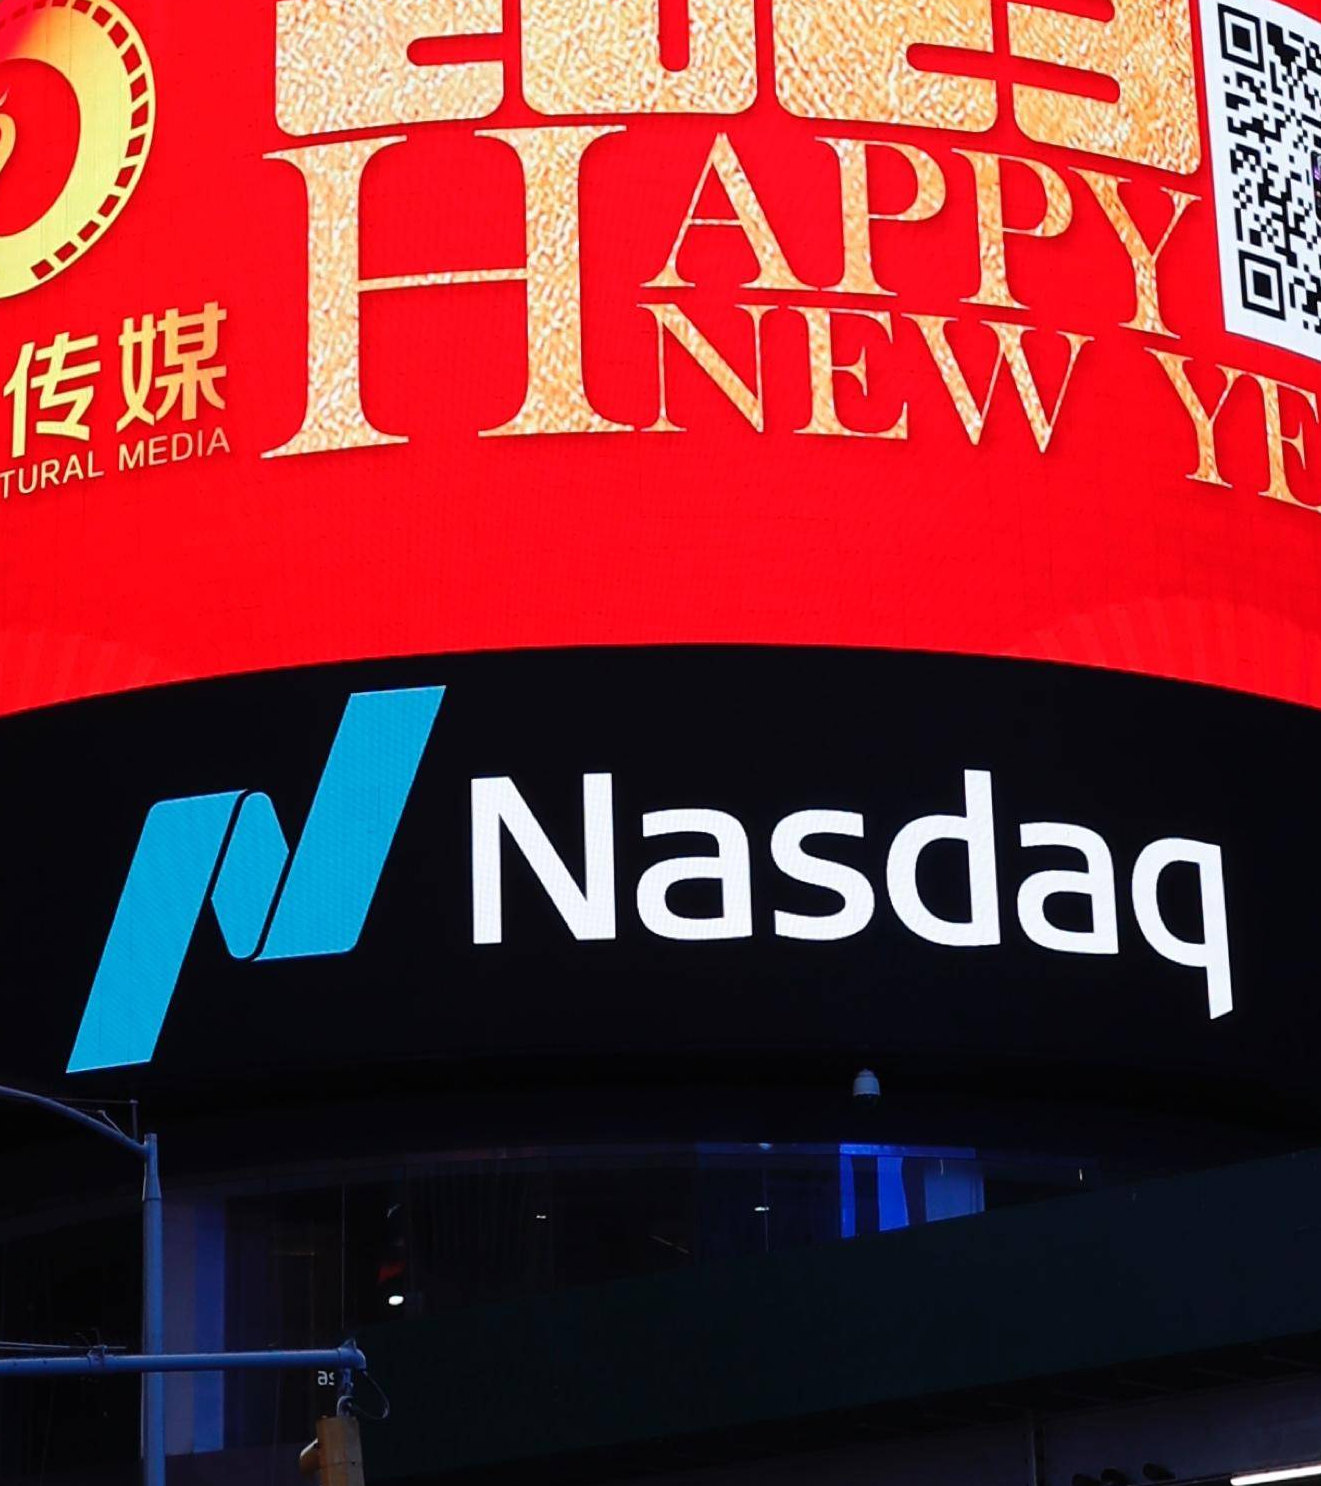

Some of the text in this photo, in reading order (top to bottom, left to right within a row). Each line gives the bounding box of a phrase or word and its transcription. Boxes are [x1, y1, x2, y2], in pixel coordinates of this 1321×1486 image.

[260, 124, 1202, 459] HAPPY
[637, 302, 1094, 454] NEW
[117, 426, 231, 472] MEDIA
[470, 769, 1236, 1021] Nasdaq
